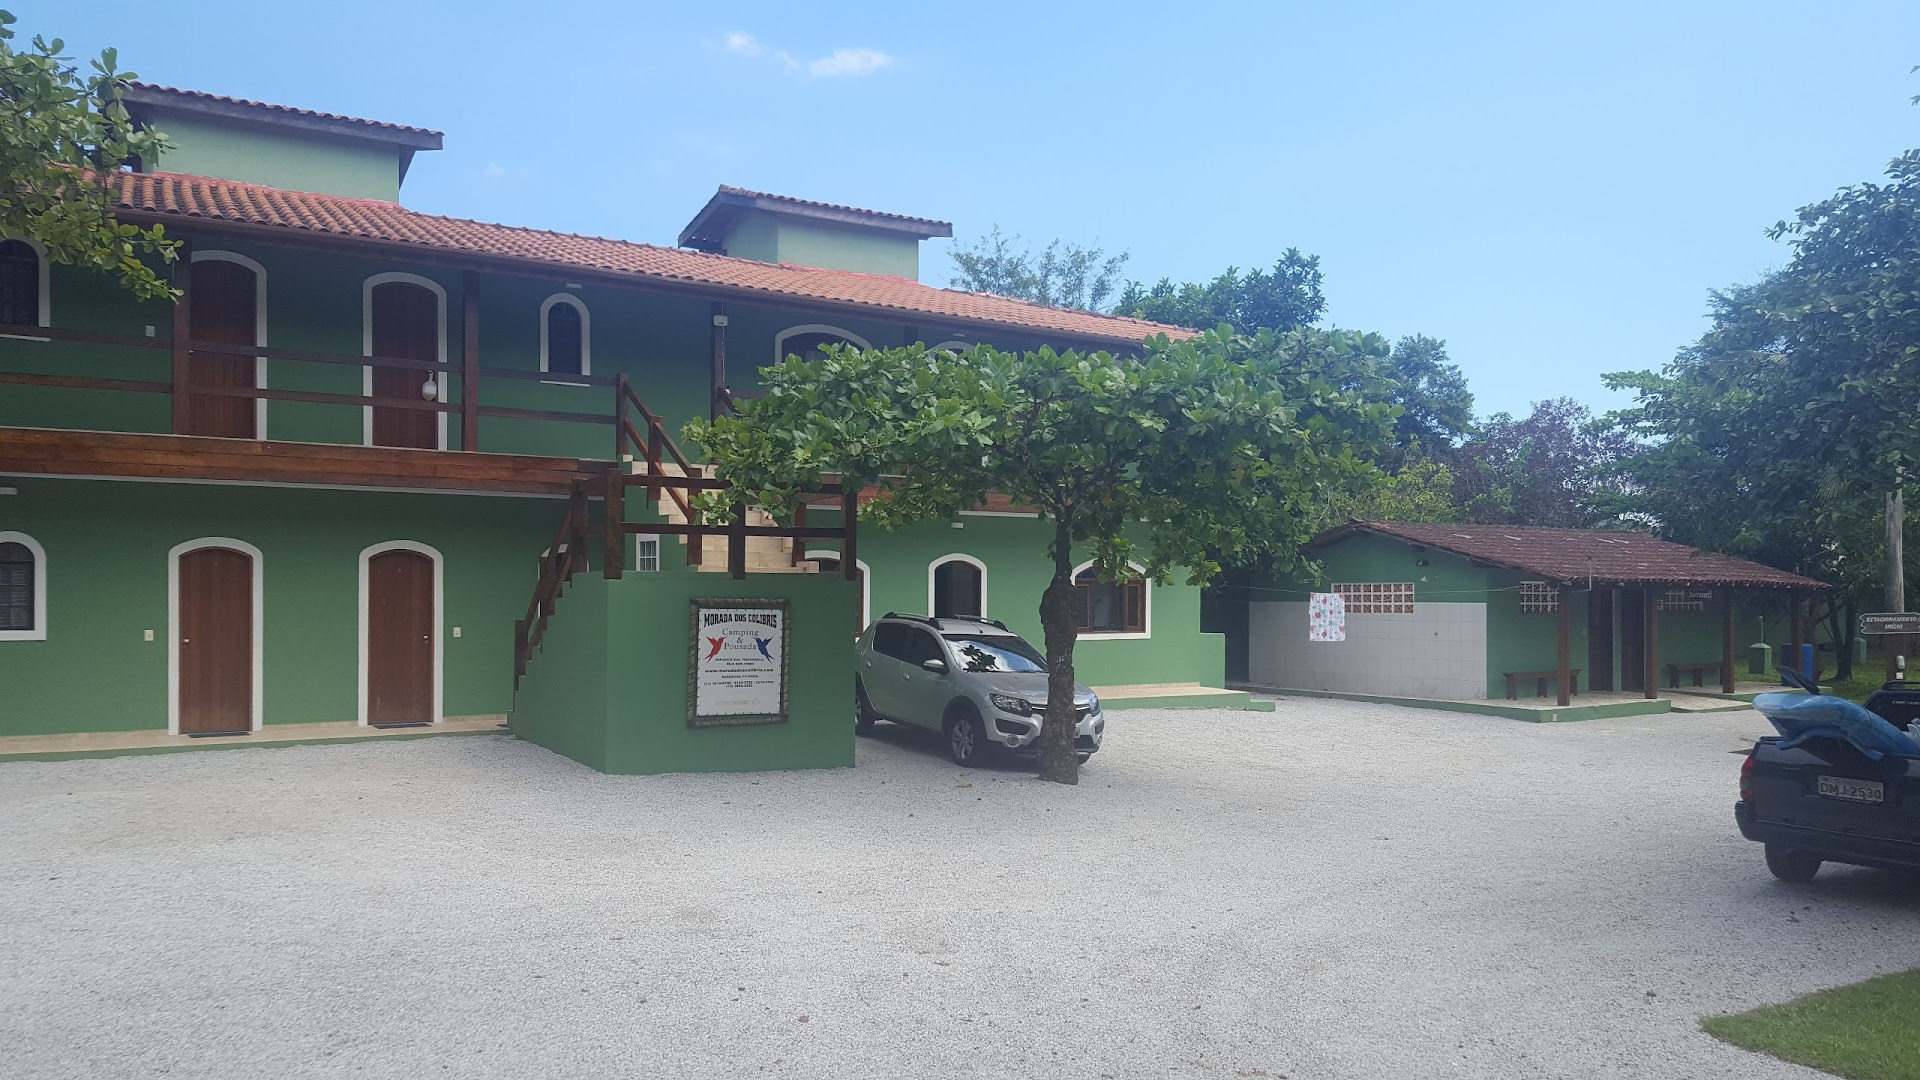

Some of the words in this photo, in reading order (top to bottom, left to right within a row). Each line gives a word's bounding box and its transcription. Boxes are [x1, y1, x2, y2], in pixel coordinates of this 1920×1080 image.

[704, 613, 732, 628] MORADA
[734, 613, 746, 622] DOS
[748, 613, 777, 628] COLIBRIS
[722, 628, 759, 637] Camping
[736, 636, 744, 644] &
[724, 642, 757, 650] Pousada
